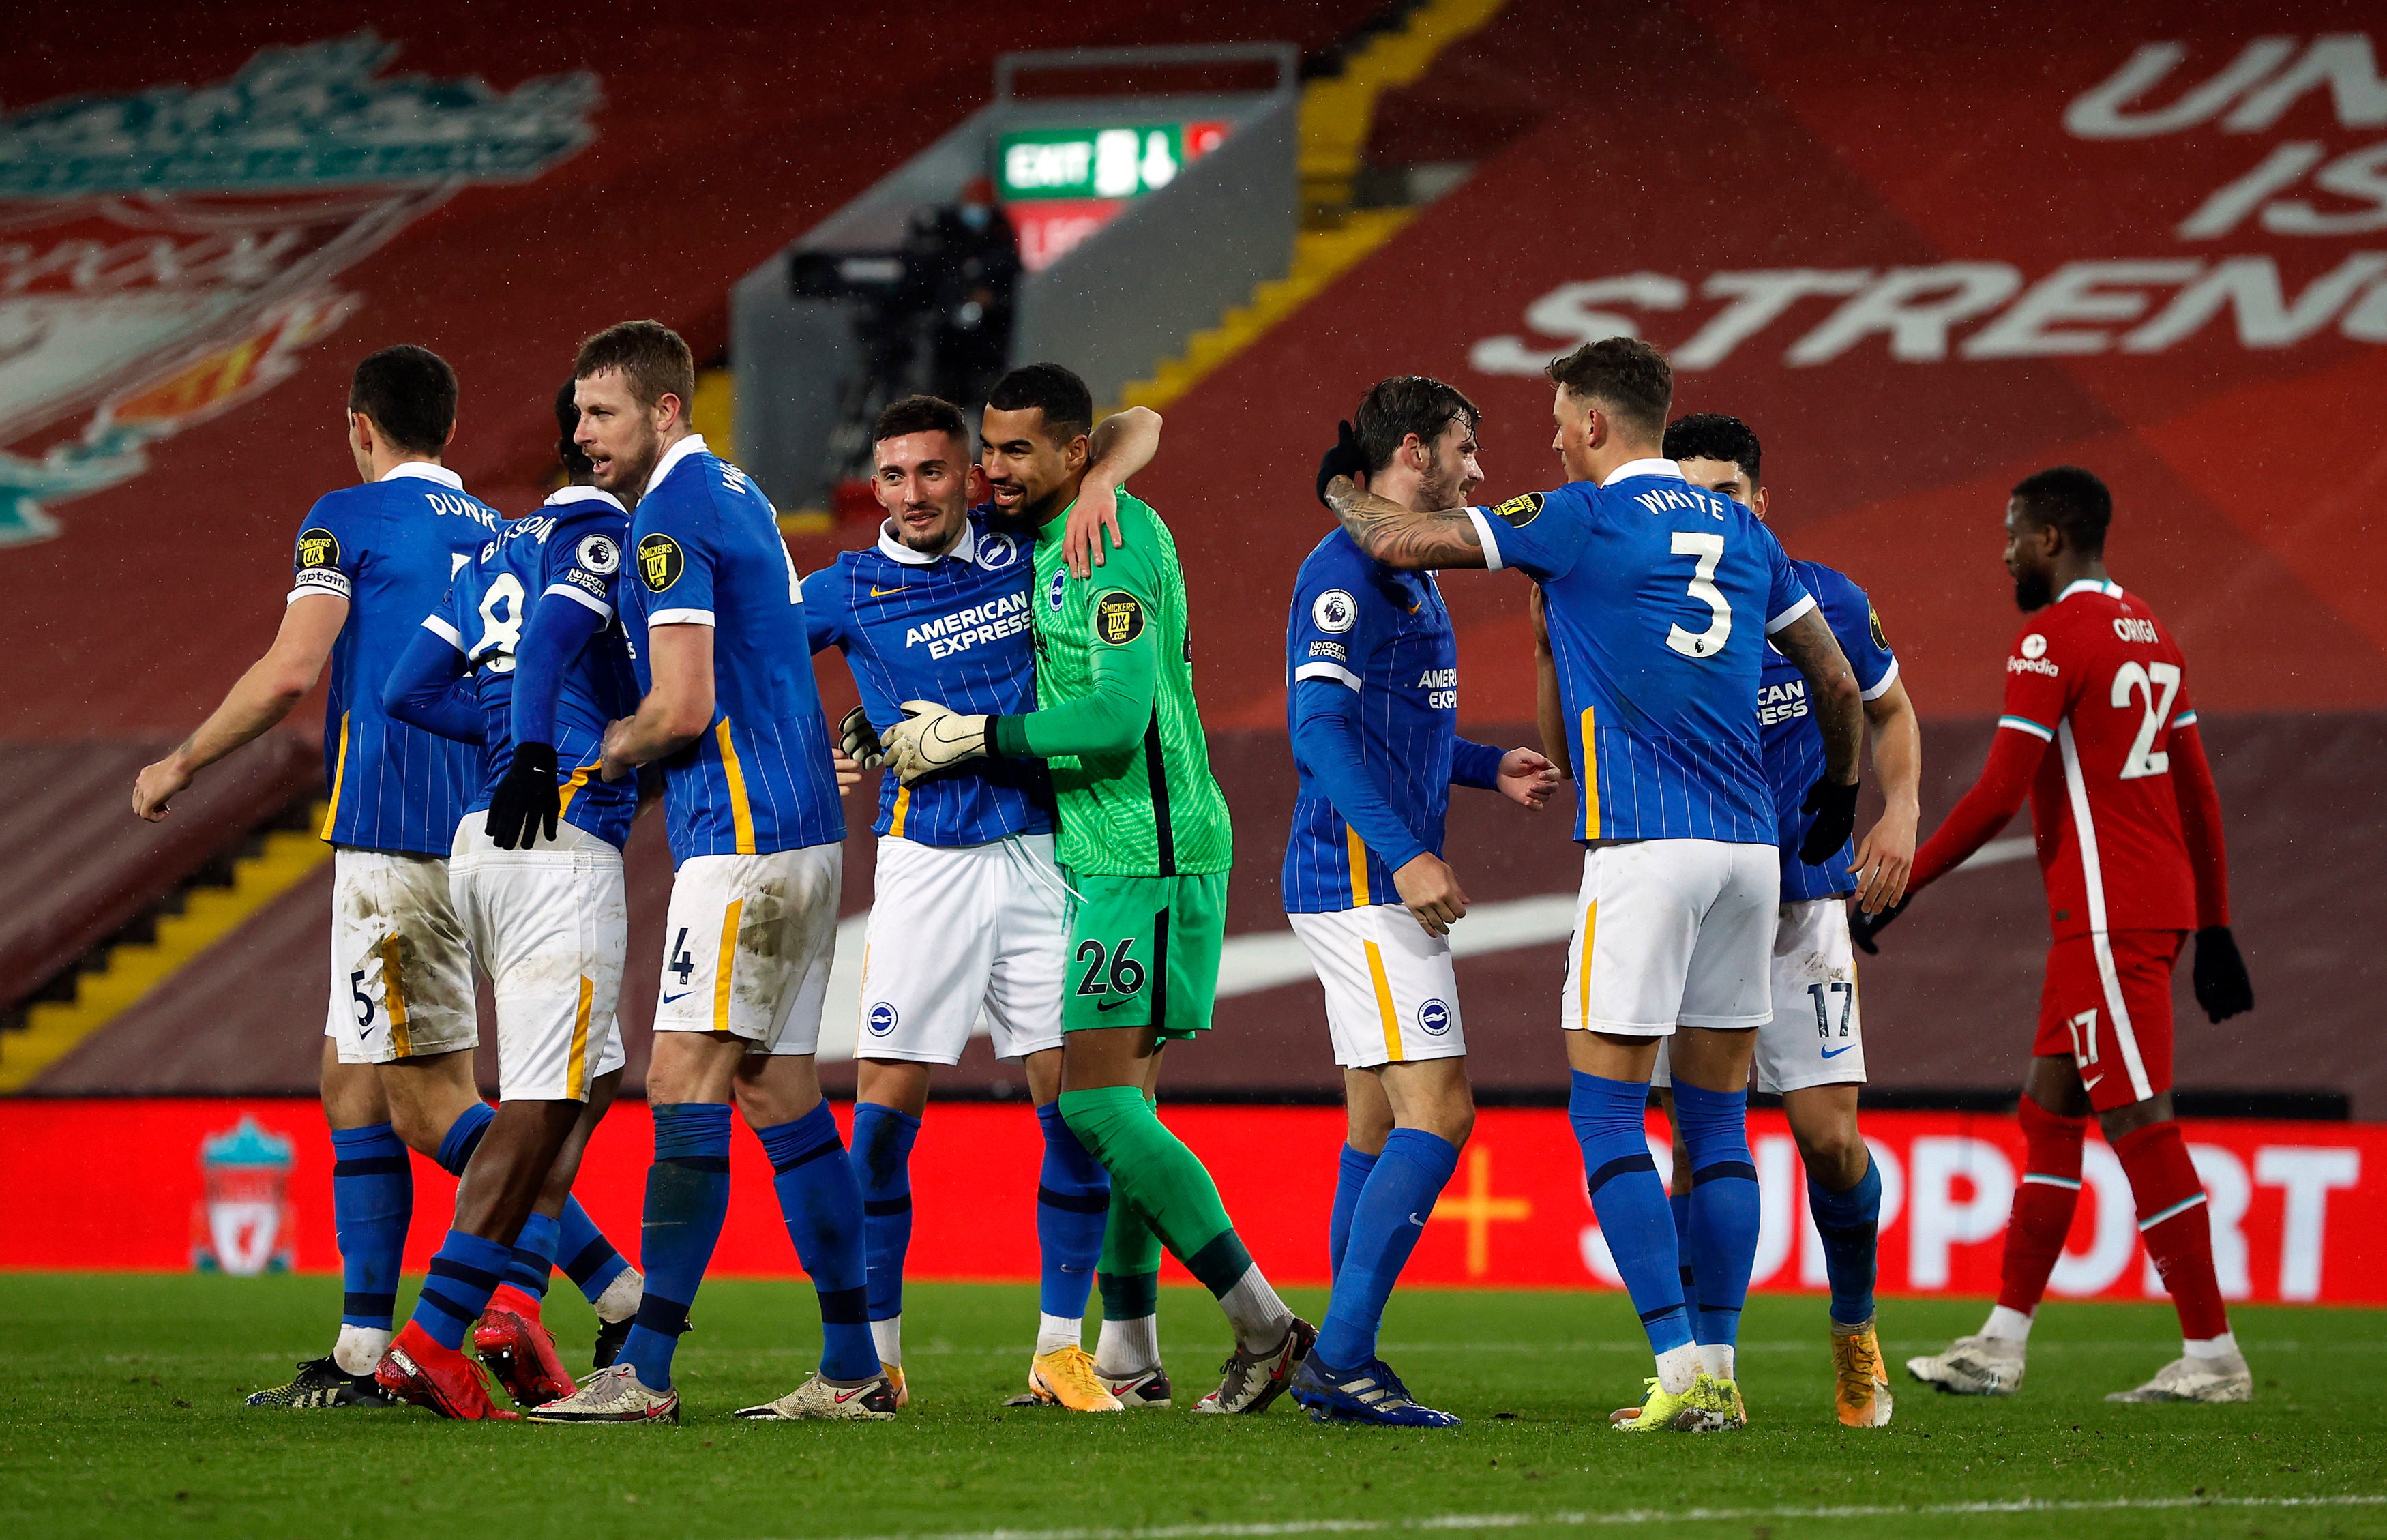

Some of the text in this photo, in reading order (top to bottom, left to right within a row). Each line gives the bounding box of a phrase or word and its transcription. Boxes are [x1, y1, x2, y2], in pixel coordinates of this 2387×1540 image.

[424, 492, 496, 533] DUNK
[1633, 489, 1724, 521] WHITE
[299, 538, 331, 550] SNICKERS
[306, 548, 321, 564] UK
[639, 544, 672, 560] SNICKERS
[568, 568, 606, 591] No room
[649, 557, 663, 576] UK
[565, 575, 606, 599] for racism
[1665, 531, 1732, 658] 3
[906, 591, 1028, 649] AMERICAN
[1101, 601, 1136, 614] SNICKERS
[469, 572, 526, 673] 8
[928, 610, 1033, 661] EXPRESS
[1111, 614, 1126, 630] UK
[2112, 617, 2159, 644] ORIGI
[1112, 632, 1127, 641] .COM
[1311, 641, 1345, 654] No room
[1309, 649, 1346, 663] for racism
[2111, 660, 2181, 780] 27
[668, 927, 695, 986] 4
[1076, 937, 1146, 996] 26
[351, 969, 375, 1027] 5
[1807, 982, 1852, 1038] 17
